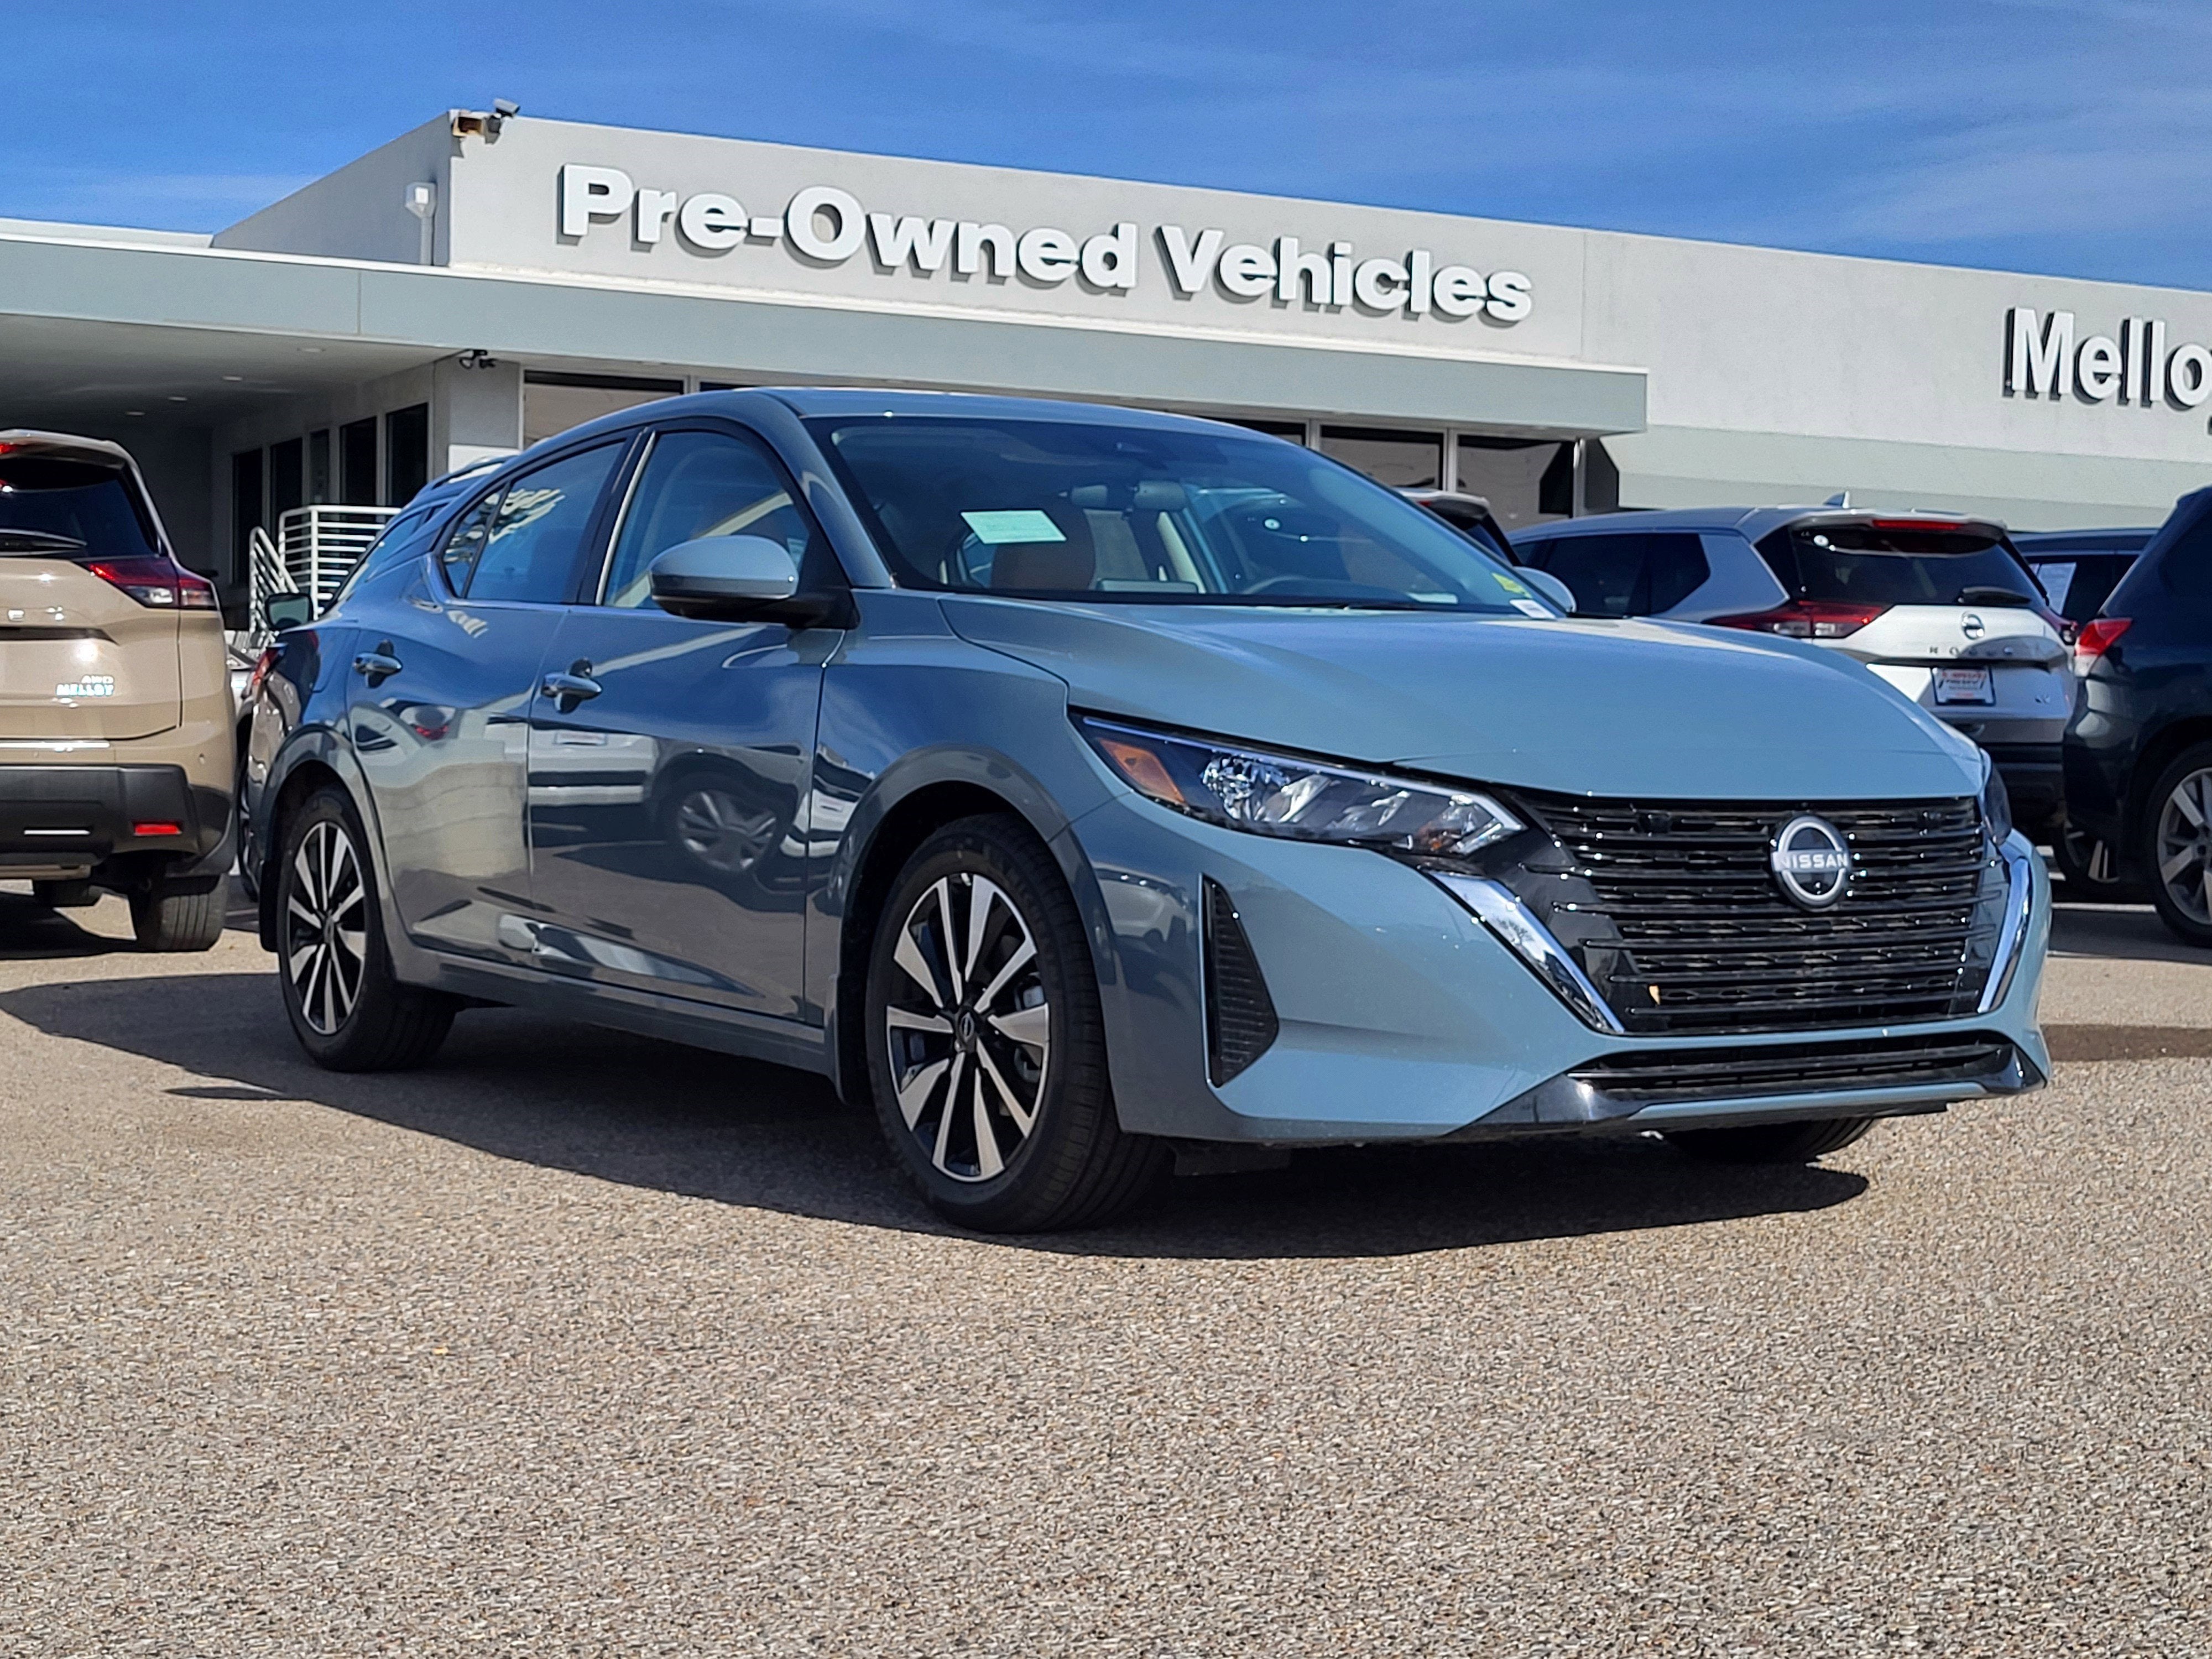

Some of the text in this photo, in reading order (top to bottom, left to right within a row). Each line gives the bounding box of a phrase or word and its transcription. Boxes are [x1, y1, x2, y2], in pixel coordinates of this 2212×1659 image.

[560, 163, 1532, 322] Pre-Owned Vehicles
[2003, 306, 2212, 409] Mello
[56, 684, 114, 696] MELLOY
[1775, 853, 1848, 870] NISSAN
